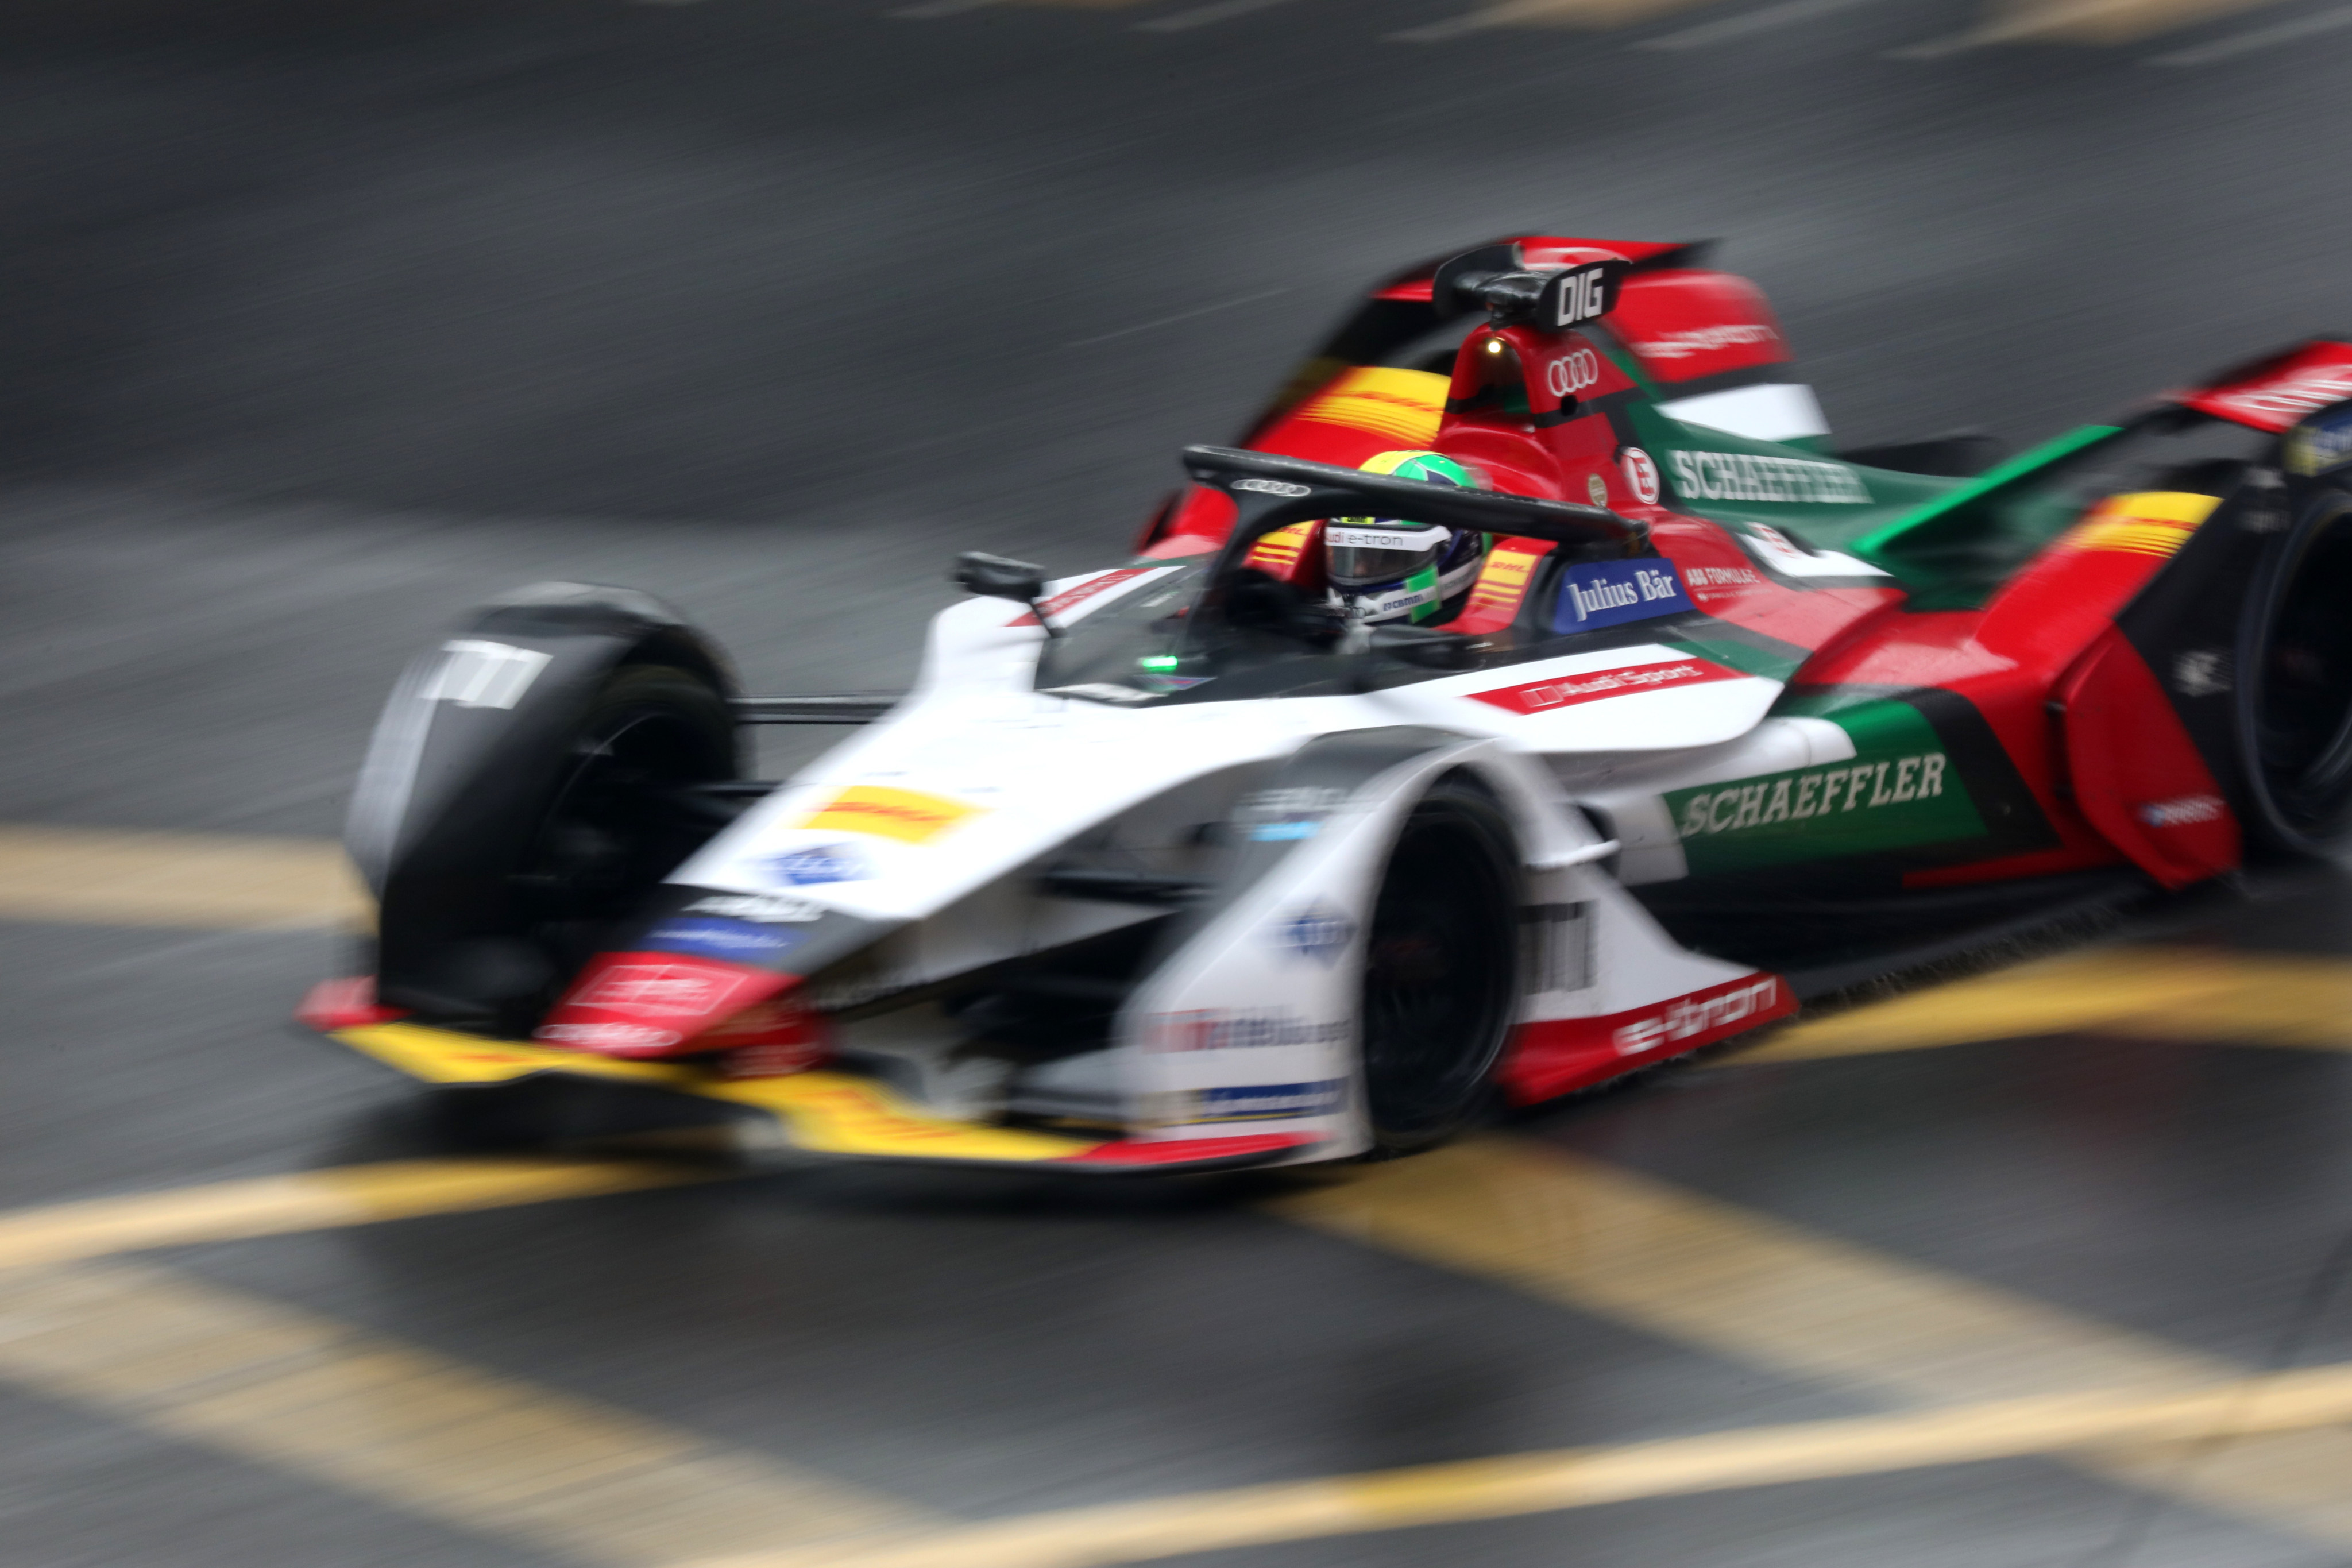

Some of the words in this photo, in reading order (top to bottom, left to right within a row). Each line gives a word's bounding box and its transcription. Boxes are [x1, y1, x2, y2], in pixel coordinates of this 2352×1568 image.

[1557, 268, 1604, 326] DIG
[1348, 534, 1403, 546] e-tron
[1567, 578, 1638, 622] Julius
[1634, 569, 1677, 602] Bär
[1681, 752, 1946, 837] SCHAEFFLER
[1611, 976, 1777, 1057] e-tron
